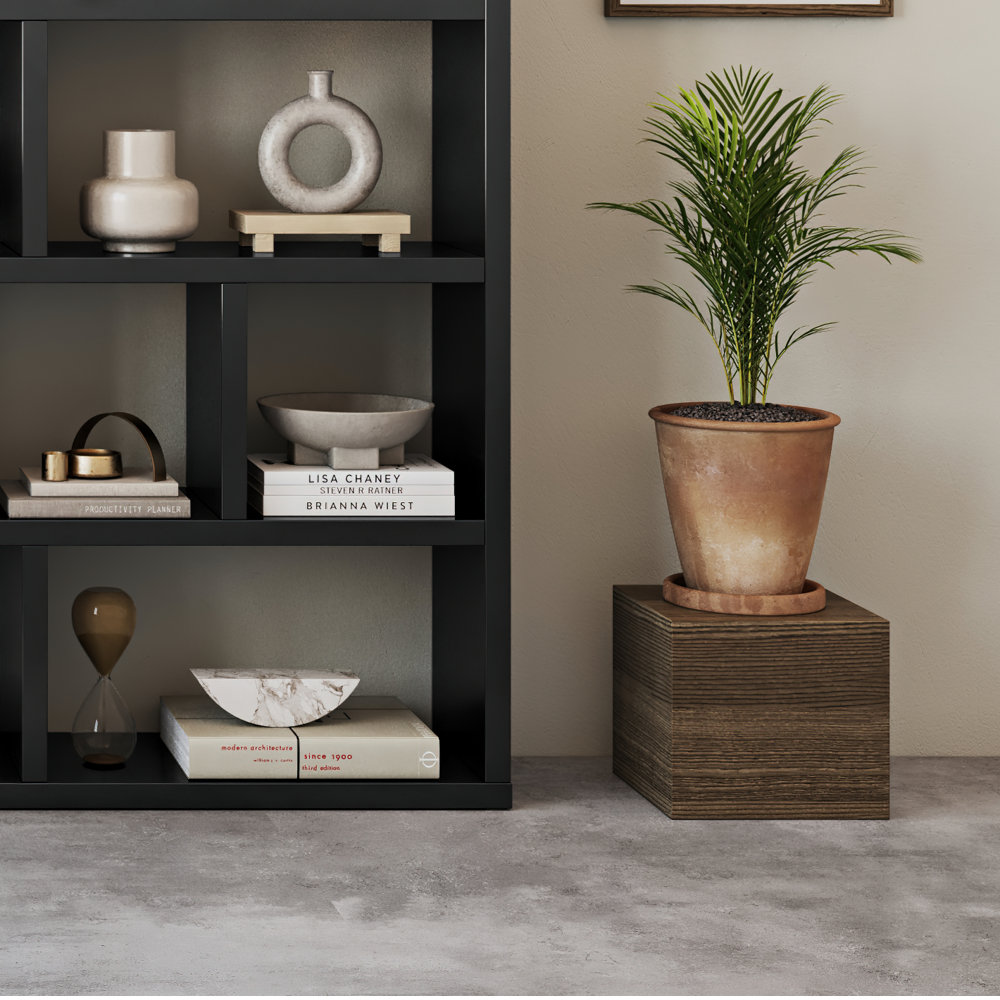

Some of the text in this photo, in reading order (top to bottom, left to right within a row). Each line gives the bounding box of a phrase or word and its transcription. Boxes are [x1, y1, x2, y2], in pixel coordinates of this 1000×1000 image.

[308, 474, 401, 483] LISA CHANEY
[319, 486, 404, 494] STEVEN R RATNER
[84, 505, 182, 514] PRODUCTIVITY PLANNER
[306, 501, 415, 510] BRIANNA WIEST
[332, 753, 353, 761] 1900
